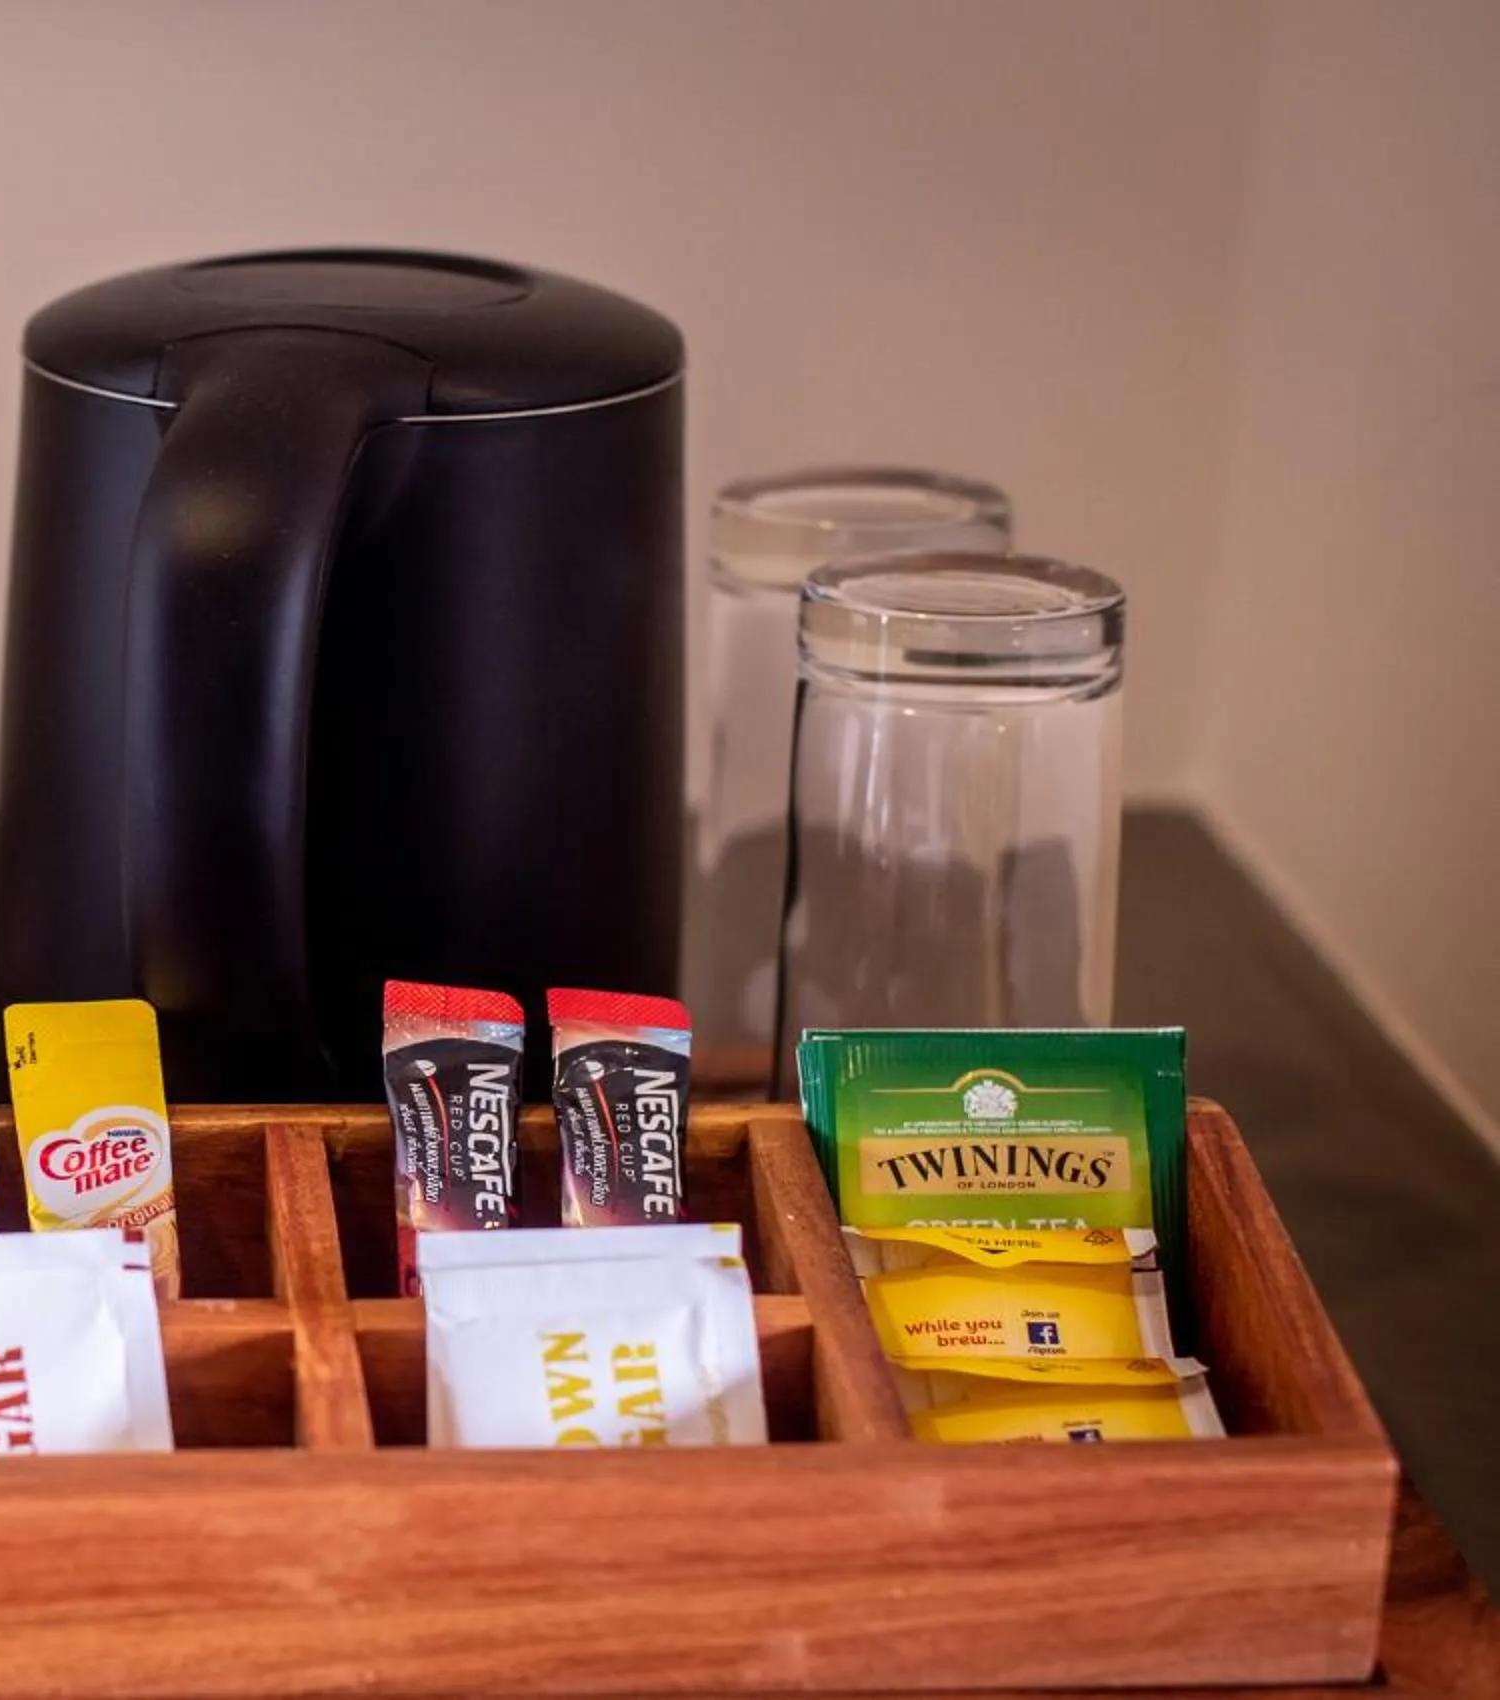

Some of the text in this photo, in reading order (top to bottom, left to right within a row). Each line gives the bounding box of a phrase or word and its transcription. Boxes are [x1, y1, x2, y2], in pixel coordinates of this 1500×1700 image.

[449, 1095, 465, 1180] RED CUP
[616, 1103, 635, 1182] RED CUP
[40, 1137, 148, 1181] Coffee
[75, 1153, 151, 1194] mate
[877, 1144, 1112, 1189] TWININGS
[980, 1181, 1036, 1189] LONDON
[904, 1319, 1002, 1336] While you
[937, 1335, 1005, 1347] brew...
